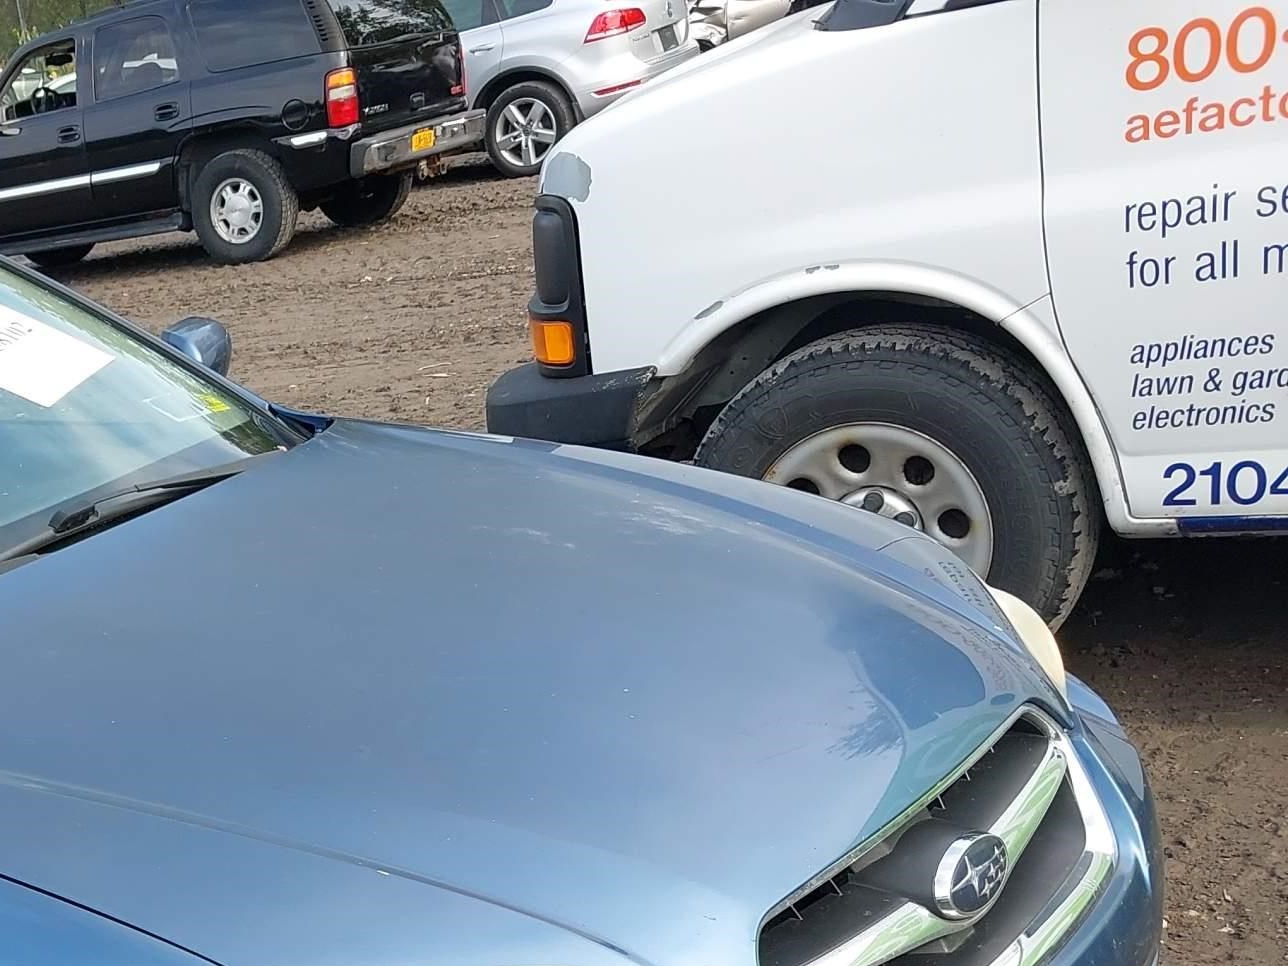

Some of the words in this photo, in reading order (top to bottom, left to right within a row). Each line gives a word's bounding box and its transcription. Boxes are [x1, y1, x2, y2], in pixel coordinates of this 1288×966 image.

[1124, 183, 1237, 239] repair
[1125, 250, 1177, 289] for
[1195, 239, 1239, 282] all
[1130, 333, 1275, 369] appliances
[1131, 373, 1194, 398] lawn
[1202, 367, 1223, 393] &
[1132, 399, 1276, 430] electronics
